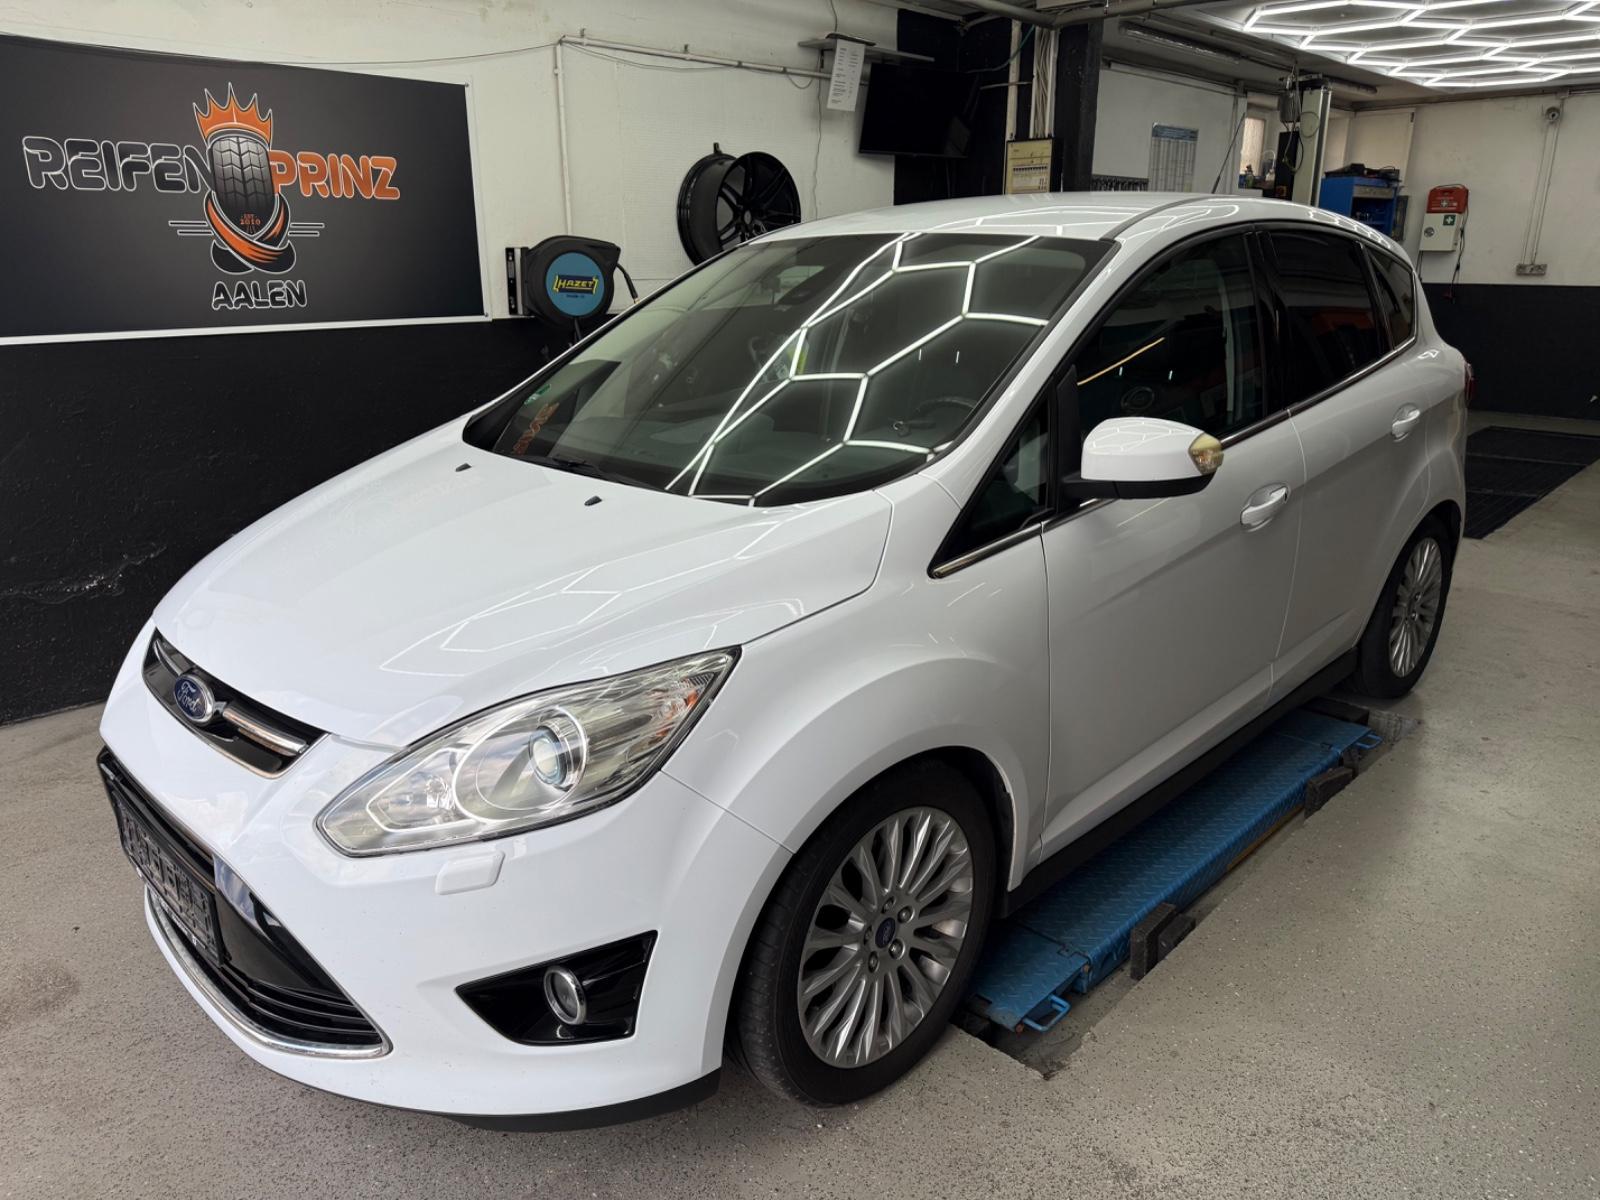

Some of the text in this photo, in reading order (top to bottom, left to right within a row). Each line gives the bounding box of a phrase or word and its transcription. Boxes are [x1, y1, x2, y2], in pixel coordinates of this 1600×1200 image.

[22, 136, 400, 200] REIFEN PRINZ
[211, 280, 307, 310] AALEN
[558, 279, 594, 288] HAZET
[177, 680, 200, 712] Ford
